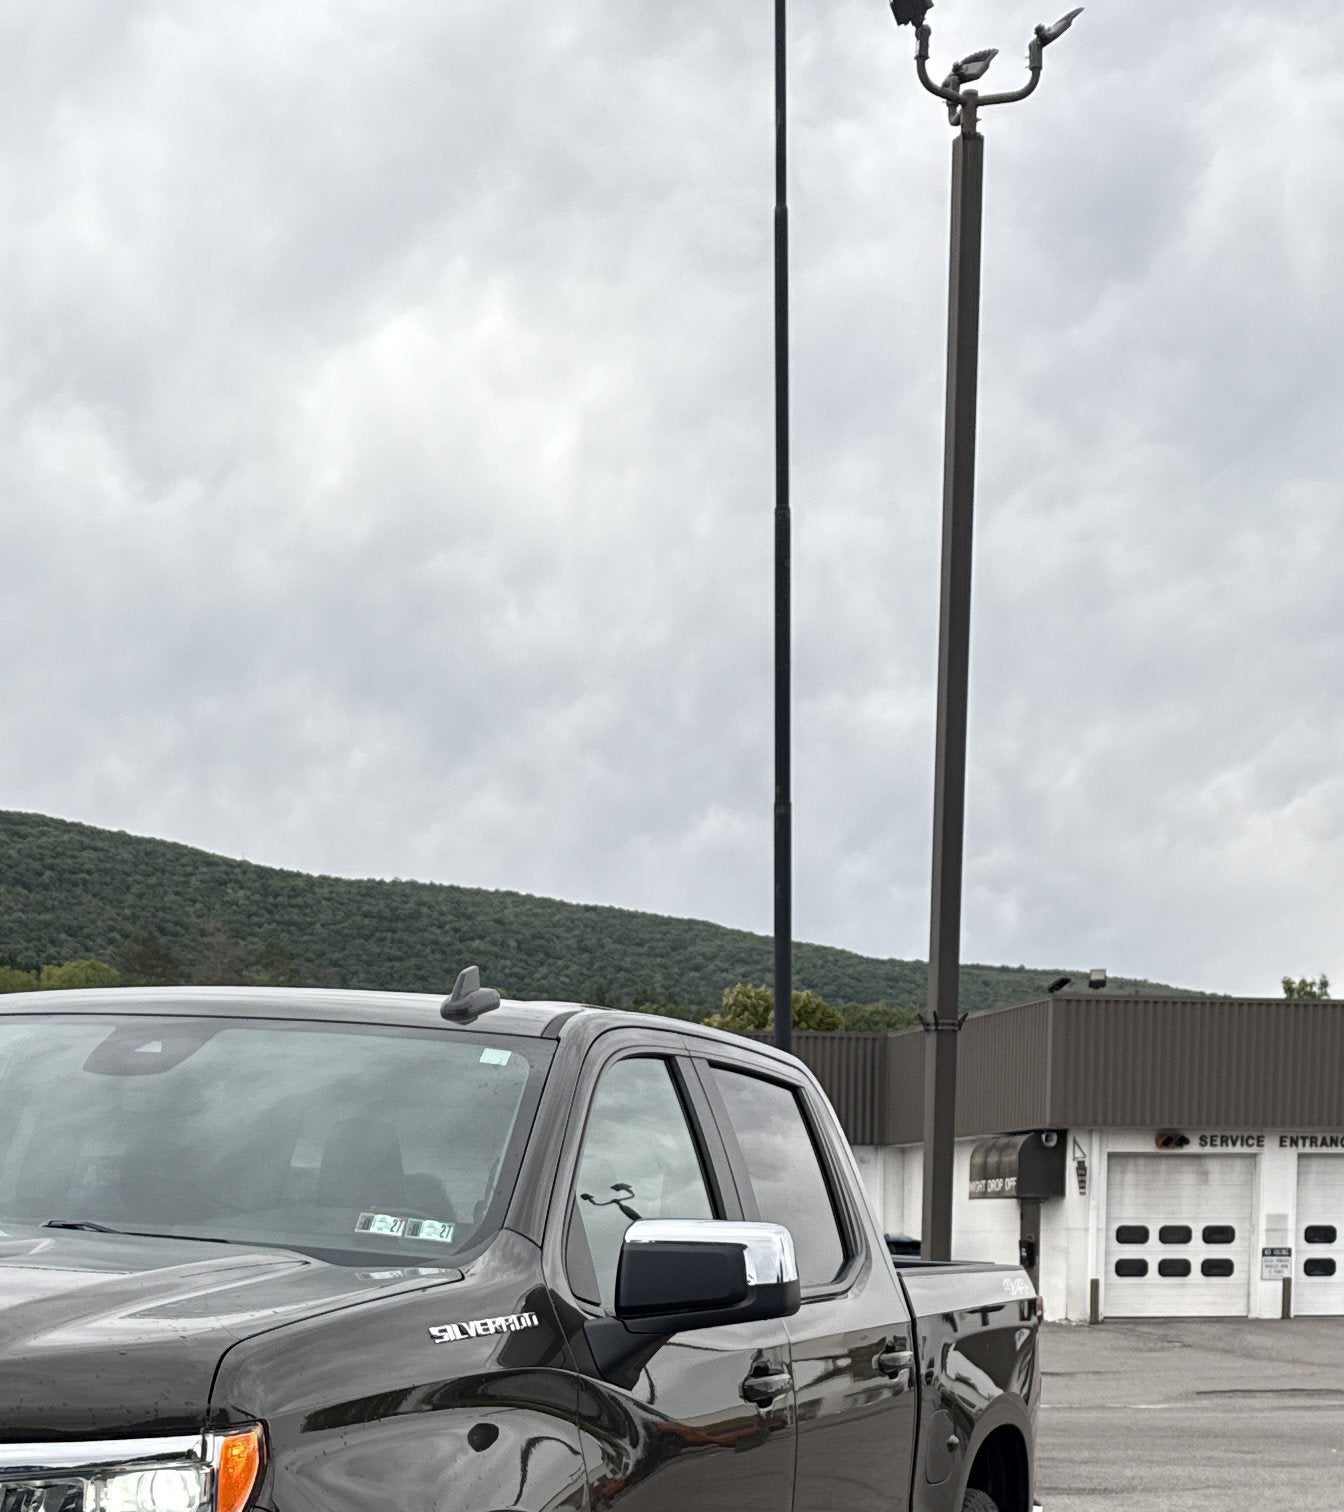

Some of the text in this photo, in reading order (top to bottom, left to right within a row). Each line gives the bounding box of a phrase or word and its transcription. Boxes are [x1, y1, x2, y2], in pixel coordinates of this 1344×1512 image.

[1198, 1134, 1265, 1148] SERVICE
[987, 1178, 1003, 1192] DROP
[1005, 1177, 1017, 1191] OFF
[440, 1224, 452, 1239] 27
